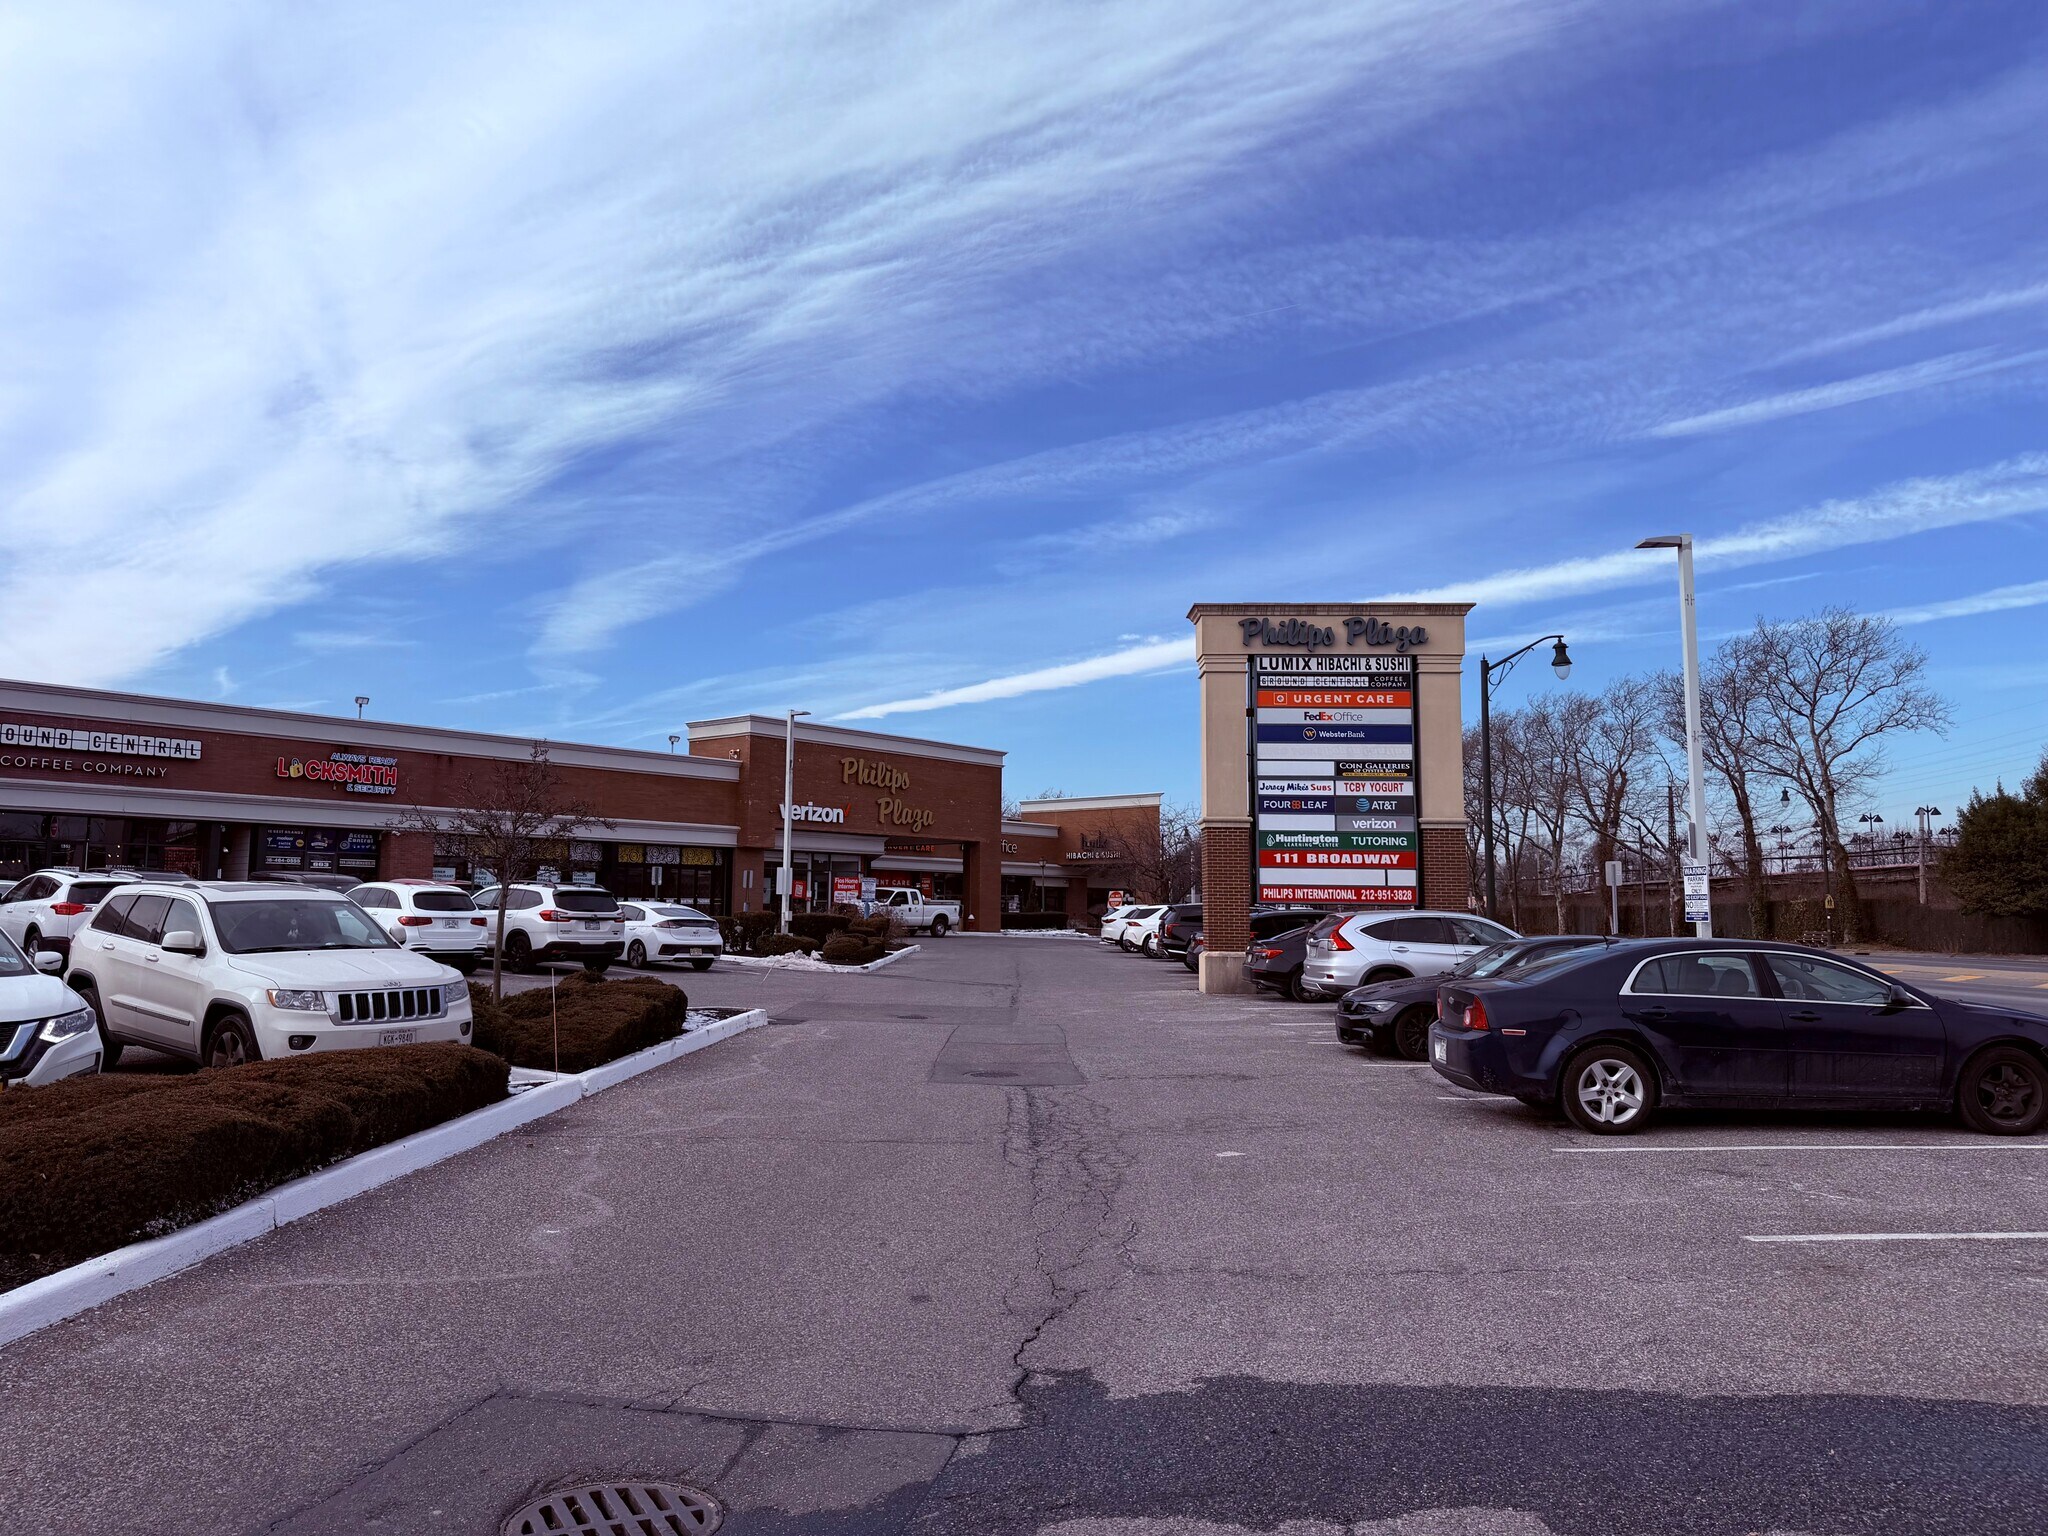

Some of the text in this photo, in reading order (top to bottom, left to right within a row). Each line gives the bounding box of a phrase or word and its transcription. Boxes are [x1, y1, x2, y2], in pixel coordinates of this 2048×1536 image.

[1238, 616, 1429, 652] Philips Plaza
[1259, 657, 1409, 671] LUMIX HIBACHI & SUSHI
[1260, 677, 1368, 686] GROUND CENTRAL
[1293, 694, 1394, 704] URGENT CARE
[5, 727, 198, 757] OUND CENTRAL
[330, 752, 398, 766] ALWAYS READY
[0, 755, 168, 778] COFFEE COMPANY
[1365, 762, 1410, 770] GALLERIES
[840, 756, 910, 795] Philips
[346, 783, 397, 795] & SECURITY
[1259, 782, 1285, 793] Jersey
[1286, 782, 1309, 792] Mike's
[1344, 782, 1404, 792] TCBY YOGURT
[1263, 800, 1328, 808] FOUR LEAF
[1371, 801, 1397, 810] AT&T
[876, 797, 935, 833] Plaza
[1352, 818, 1397, 829] verizon
[1275, 834, 1339, 845] Huntington
[1351, 836, 1408, 846] TUTORING
[915, 844, 936, 852] CARE
[1000, 839, 1018, 854] fice
[1066, 851, 1094, 859] HIBACHI
[1273, 853, 1400, 865] 111 BROADWAY
[1684, 867, 1706, 875] WARNING
[1263, 888, 1413, 901] PHILIPS INTERNATIONAL 212-951-3828
[1685, 901, 1694, 909] NO
